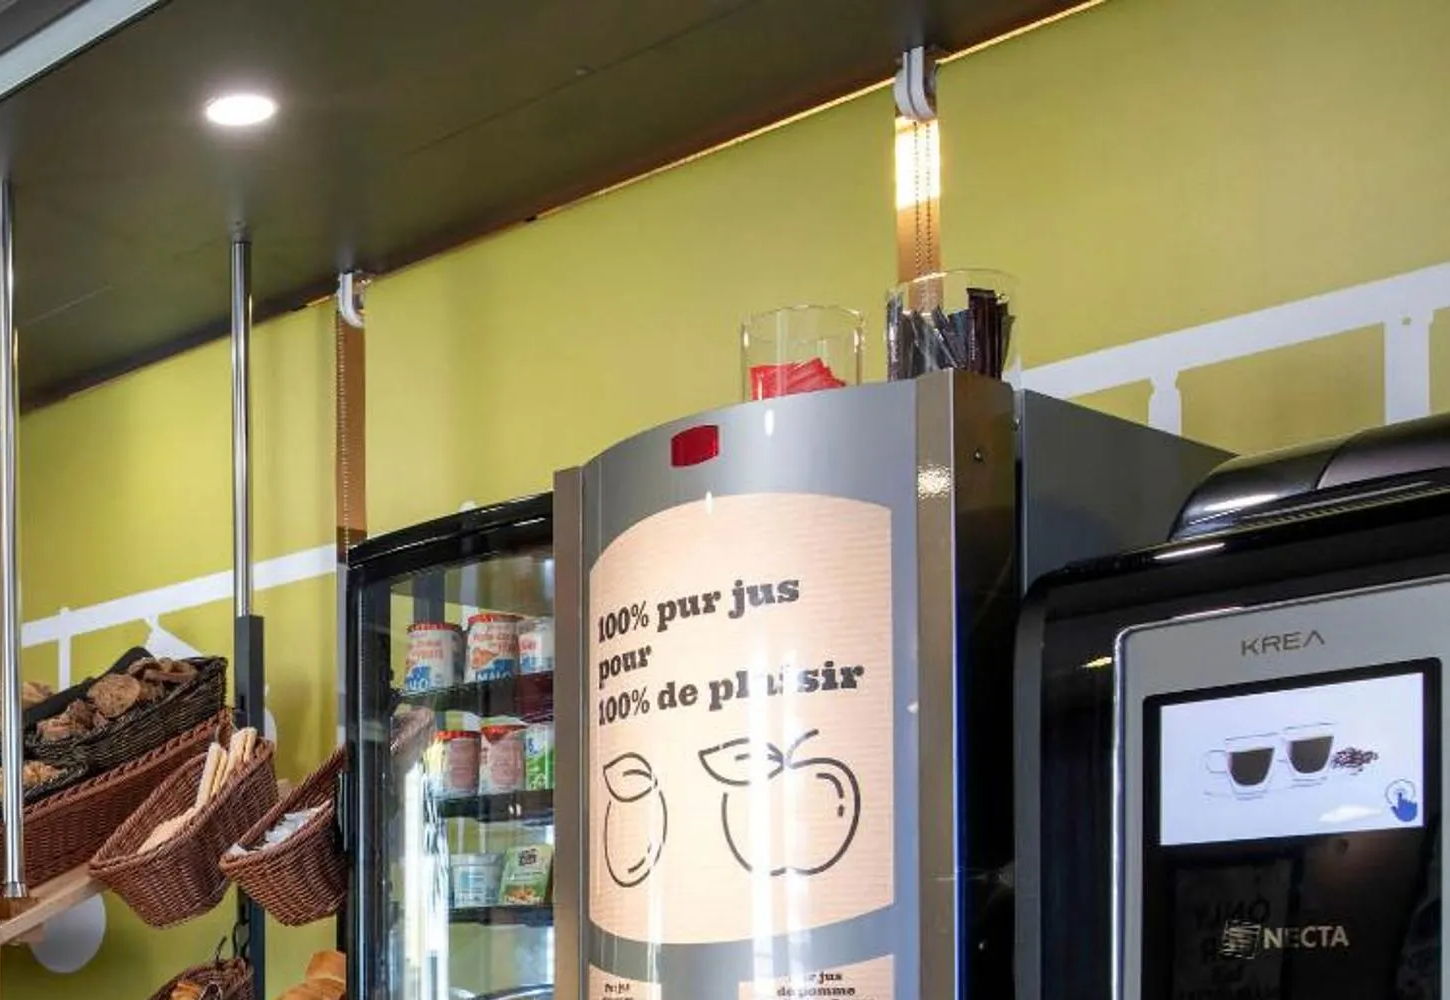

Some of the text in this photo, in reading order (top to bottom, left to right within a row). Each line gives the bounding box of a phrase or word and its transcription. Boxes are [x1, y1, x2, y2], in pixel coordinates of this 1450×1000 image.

[598, 578, 801, 642] 100% pur jus
[598, 644, 652, 688] pour
[598, 687, 650, 725] 100%
[657, 682, 698, 710] de
[1263, 925, 1350, 950] NECTA
